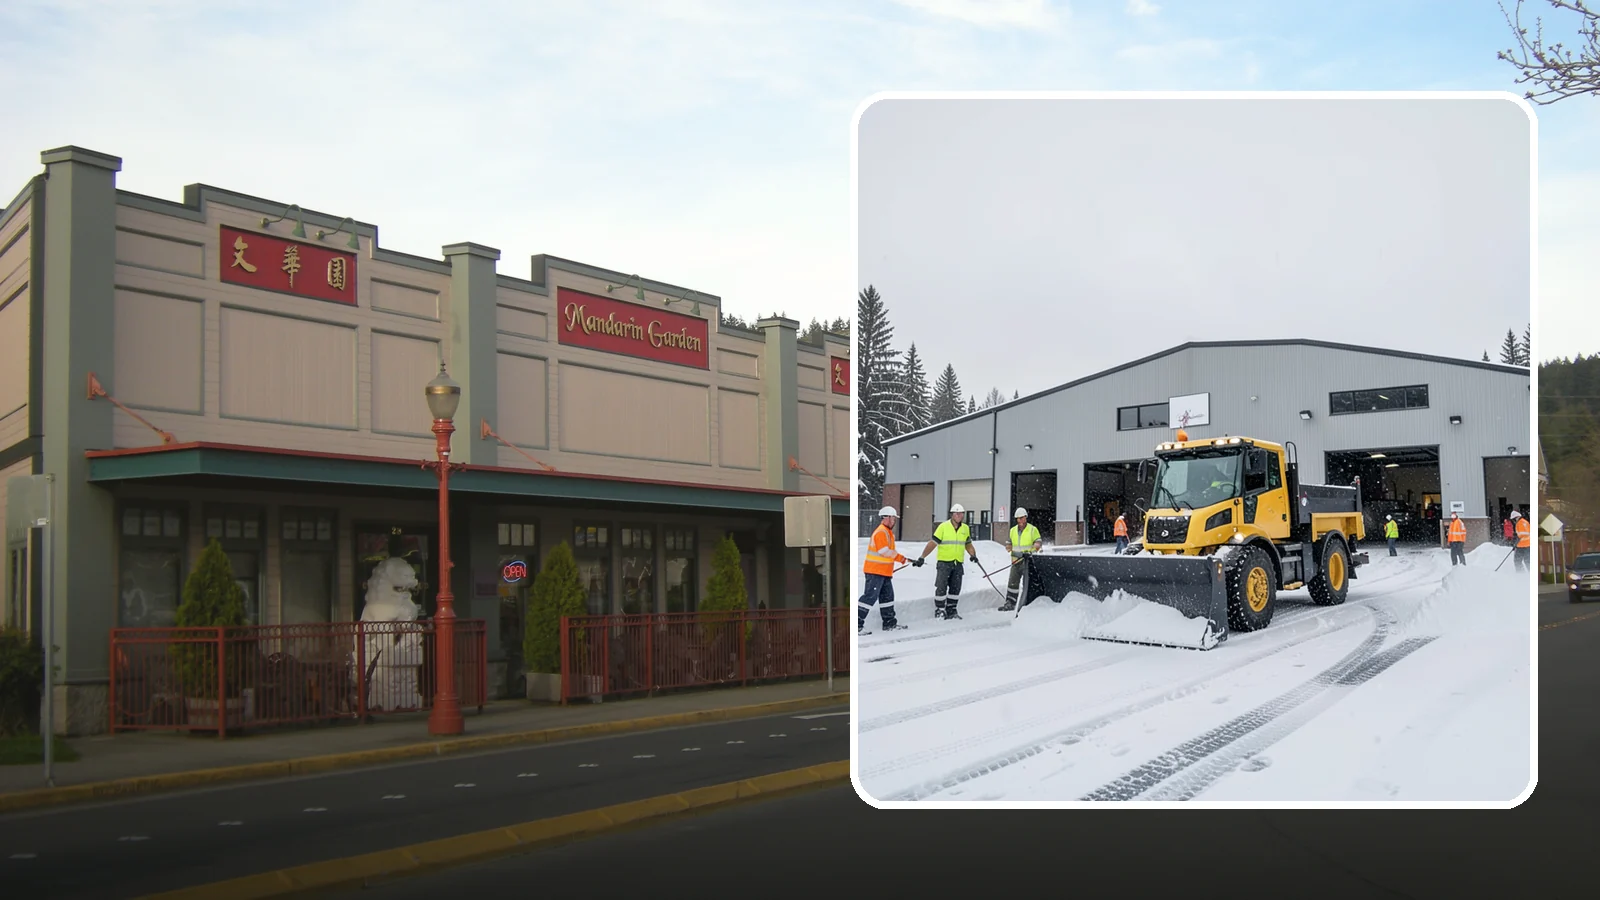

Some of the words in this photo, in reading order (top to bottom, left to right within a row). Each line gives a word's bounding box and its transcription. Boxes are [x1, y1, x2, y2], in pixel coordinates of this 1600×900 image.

[231, 236, 346, 291] 文華園
[564, 302, 644, 341] Mandarin
[648, 320, 702, 352] Garden
[503, 565, 527, 578] OPEN
